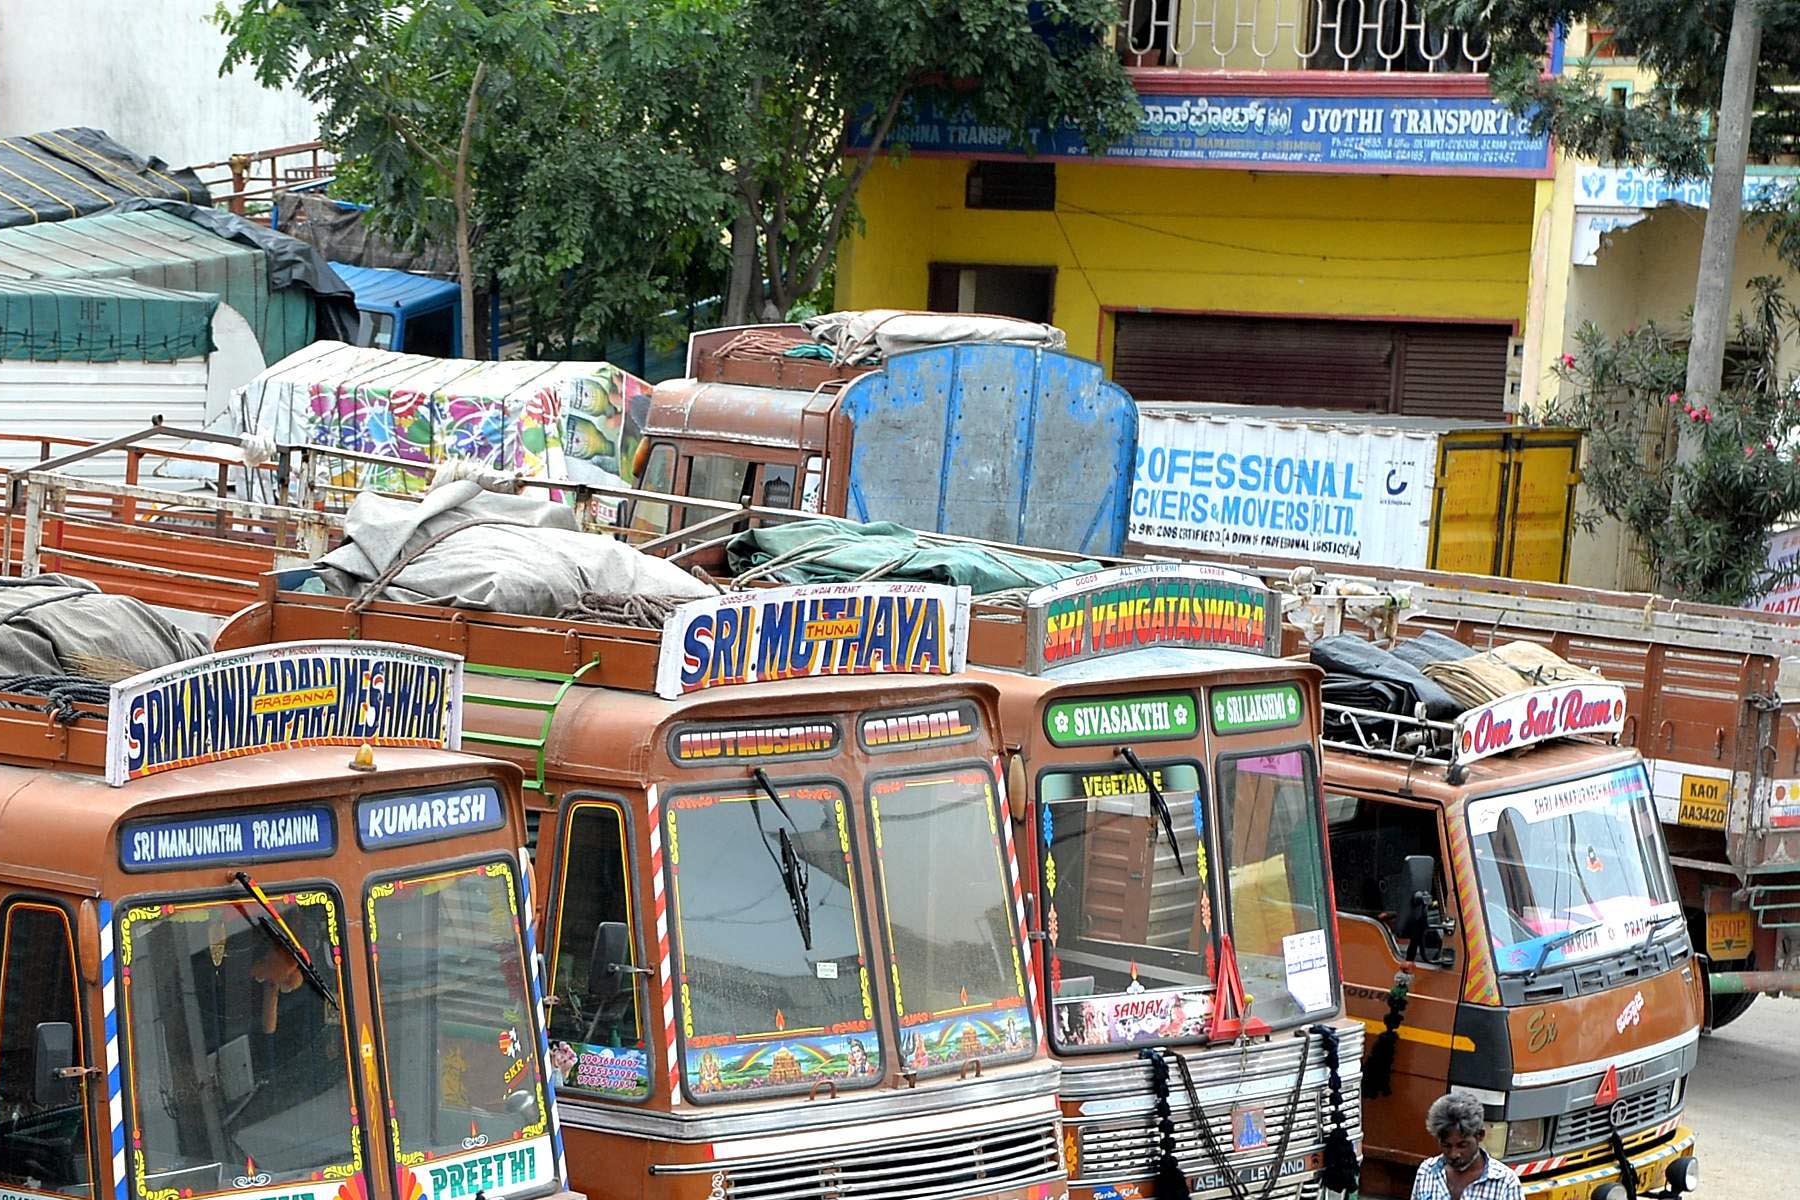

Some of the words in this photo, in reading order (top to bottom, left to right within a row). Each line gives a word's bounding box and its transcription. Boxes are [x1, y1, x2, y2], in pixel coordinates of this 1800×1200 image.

[882, 124, 940, 143] RISHNA
[949, 126, 1040, 146] TRANSPT
[1302, 108, 1384, 135] JYOTHI
[1391, 108, 1512, 136] TRANSPORT
[1134, 447, 1363, 500] ROFESSIONAL
[1133, 487, 1208, 524] CKERS
[1221, 499, 1310, 532] MOVERS
[805, 622, 860, 639] THUNAI
[1043, 600, 1083, 663] SRI
[1092, 583, 1266, 653] VENGATASWARA
[681, 606, 747, 686] SRI
[755, 594, 946, 681] MUTHAYA
[253, 689, 336, 711] PRASANNA
[865, 709, 971, 746] ANDAL
[1073, 702, 1171, 737] SIVASAKTHI
[1473, 709, 1514, 756] Om
[1519, 695, 1558, 743] Sai
[1562, 690, 1613, 731] Ram
[1081, 771, 1164, 799] VEGETABE
[1690, 782, 1719, 800] KA01
[367, 794, 487, 840] KUMARESH
[1680, 803, 1725, 825] AA3420
[133, 832, 155, 862] SRI
[157, 821, 243, 861] MANJUNATHA
[252, 813, 320, 850] PRASANNA
[1710, 917, 1747, 939] STOP
[1113, 998, 1165, 1020] SANJAY
[503, 1058, 525, 1084] SKR
[1195, 1167, 1242, 1192] ASHK
[1250, 1159, 1306, 1184] LEYAND
